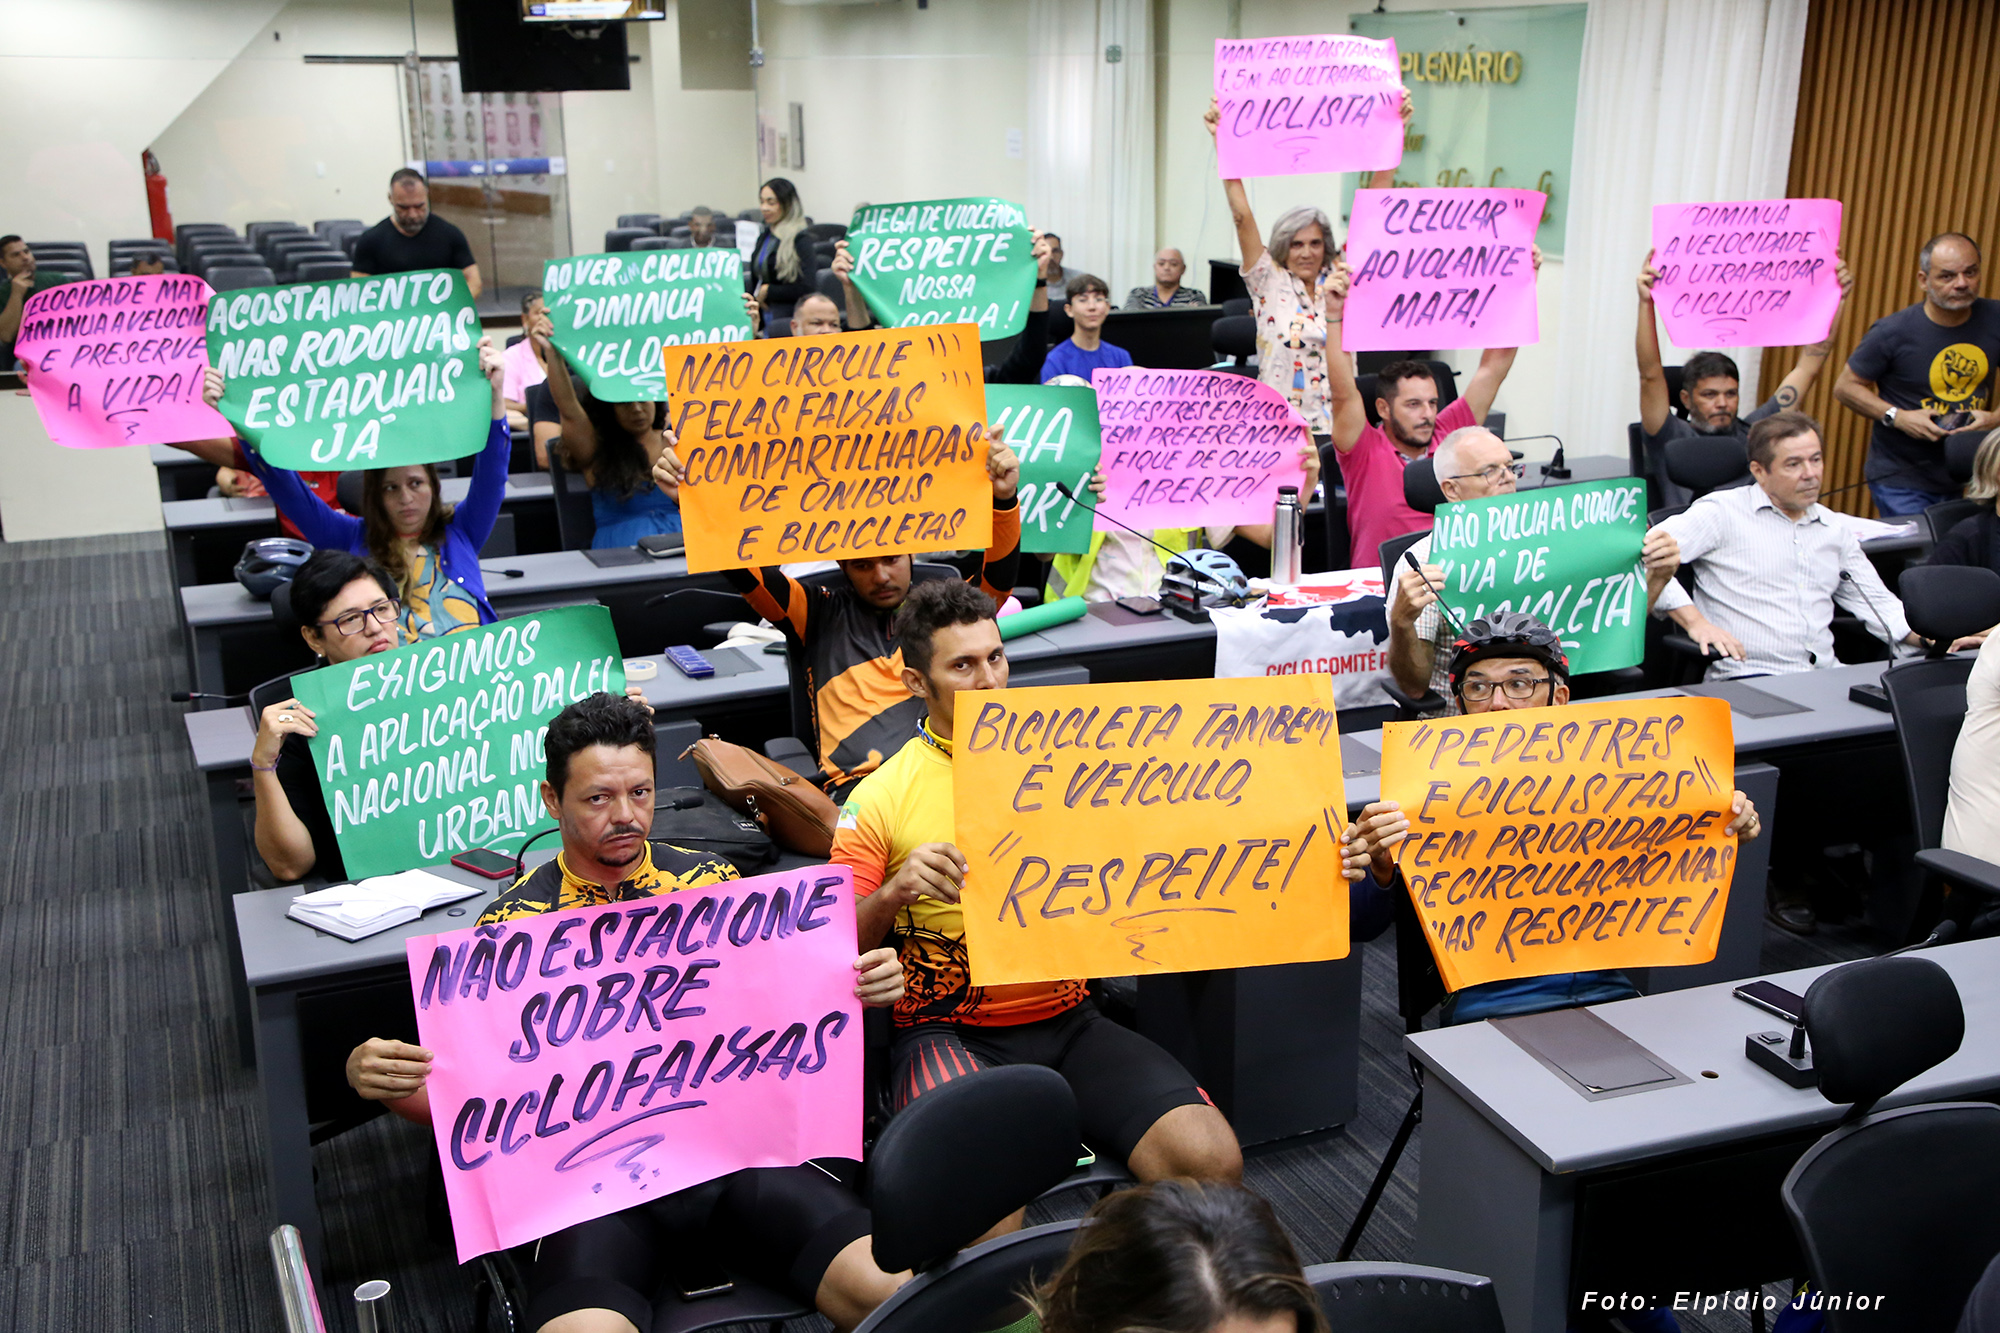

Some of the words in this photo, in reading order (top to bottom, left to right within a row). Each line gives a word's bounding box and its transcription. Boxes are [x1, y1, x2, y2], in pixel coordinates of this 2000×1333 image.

[1218, 40, 1313, 63] MANTENHA
[1400, 44, 1523, 84] PLENÁRIO
[1268, 67, 1291, 86] AO
[1222, 92, 1393, 137] "CICLISTA"
[918, 205, 944, 232] DE
[1380, 196, 1524, 238] "CELULAR"
[855, 233, 1013, 279] RESPEITE
[1354, 249, 1399, 286] AO
[1403, 245, 1525, 279] VOLANTE
[1664, 237, 1680, 256] A
[544, 263, 572, 292] AO
[574, 257, 622, 287] VER
[641, 250, 740, 284] CICLISTA
[898, 274, 976, 305] NOSSA
[1653, 264, 1680, 285] AO
[27, 281, 146, 317] ELOCIDADE
[208, 272, 453, 335] ACOSTAMENTO
[557, 283, 723, 330] "DIMINUA"
[1382, 284, 1496, 328] MATA!
[1672, 290, 1791, 318] CICLISTA
[40, 350, 61, 372] E
[71, 337, 206, 368] PRESERVE
[217, 335, 288, 379] NAS
[290, 307, 475, 376] RODOVIAS
[68, 383, 81, 412] A
[103, 364, 202, 410] VIDA!
[677, 344, 752, 394] NÃO
[762, 340, 912, 388] CIRCULE
[244, 358, 464, 428] ESTADUAIS
[675, 395, 790, 440] PELAS
[796, 382, 926, 431] FAIXAS
[1098, 400, 1208, 421] PEDESTRES
[310, 413, 396, 463] JÁ
[684, 422, 983, 487] COMPARTILHADAS
[1100, 424, 1141, 444] TEM
[1146, 420, 1301, 447] PREFERÊNCIA
[1111, 450, 1182, 470] FIQUE
[1187, 449, 1216, 468] DE
[1220, 450, 1281, 469] OLHO
[739, 484, 788, 512] DE
[800, 472, 933, 512] ÔNIBUS
[1126, 474, 1270, 510] ABERTO!
[738, 526, 762, 561] E
[778, 508, 966, 554] BICICLETAS
[1433, 503, 1479, 553] NÃO
[1487, 500, 1549, 542] POLUA
[1551, 497, 1566, 531] A
[1571, 487, 1641, 524] CIDADE,
[1514, 547, 1549, 584] DE
[347, 620, 541, 711] EXIGIMOS
[1266, 659, 1313, 676] CICLO
[1317, 649, 1376, 675] COMITÊ
[327, 735, 347, 782] A
[360, 671, 524, 769] APLICAÇÃO
[531, 667, 564, 716] DA
[569, 656, 614, 702] LEI
[968, 702, 1183, 755] BICICLETA
[1193, 697, 1333, 751] TAMBÉM
[1408, 714, 1684, 769] "PEDESTRES
[335, 740, 496, 834] NACIONAL
[1012, 752, 1053, 813] É
[1064, 756, 1252, 809] VEÍCULO,
[1419, 781, 1451, 824] E
[1457, 755, 1720, 818] CICLISTAS"
[1398, 829, 1478, 868] TEM
[1486, 811, 1721, 860] PRIORIDADE
[1410, 871, 1450, 908] DE
[1447, 847, 1671, 906] CIRCULAÇÃO
[1668, 845, 1734, 884] NAS
[420, 924, 533, 1009] NÃO
[539, 876, 844, 978] ESTACIONE
[1495, 888, 1718, 963] RESPEITE!
[508, 959, 720, 1063] SOBRE
[450, 1010, 850, 1171] CICLOFAIXAS
